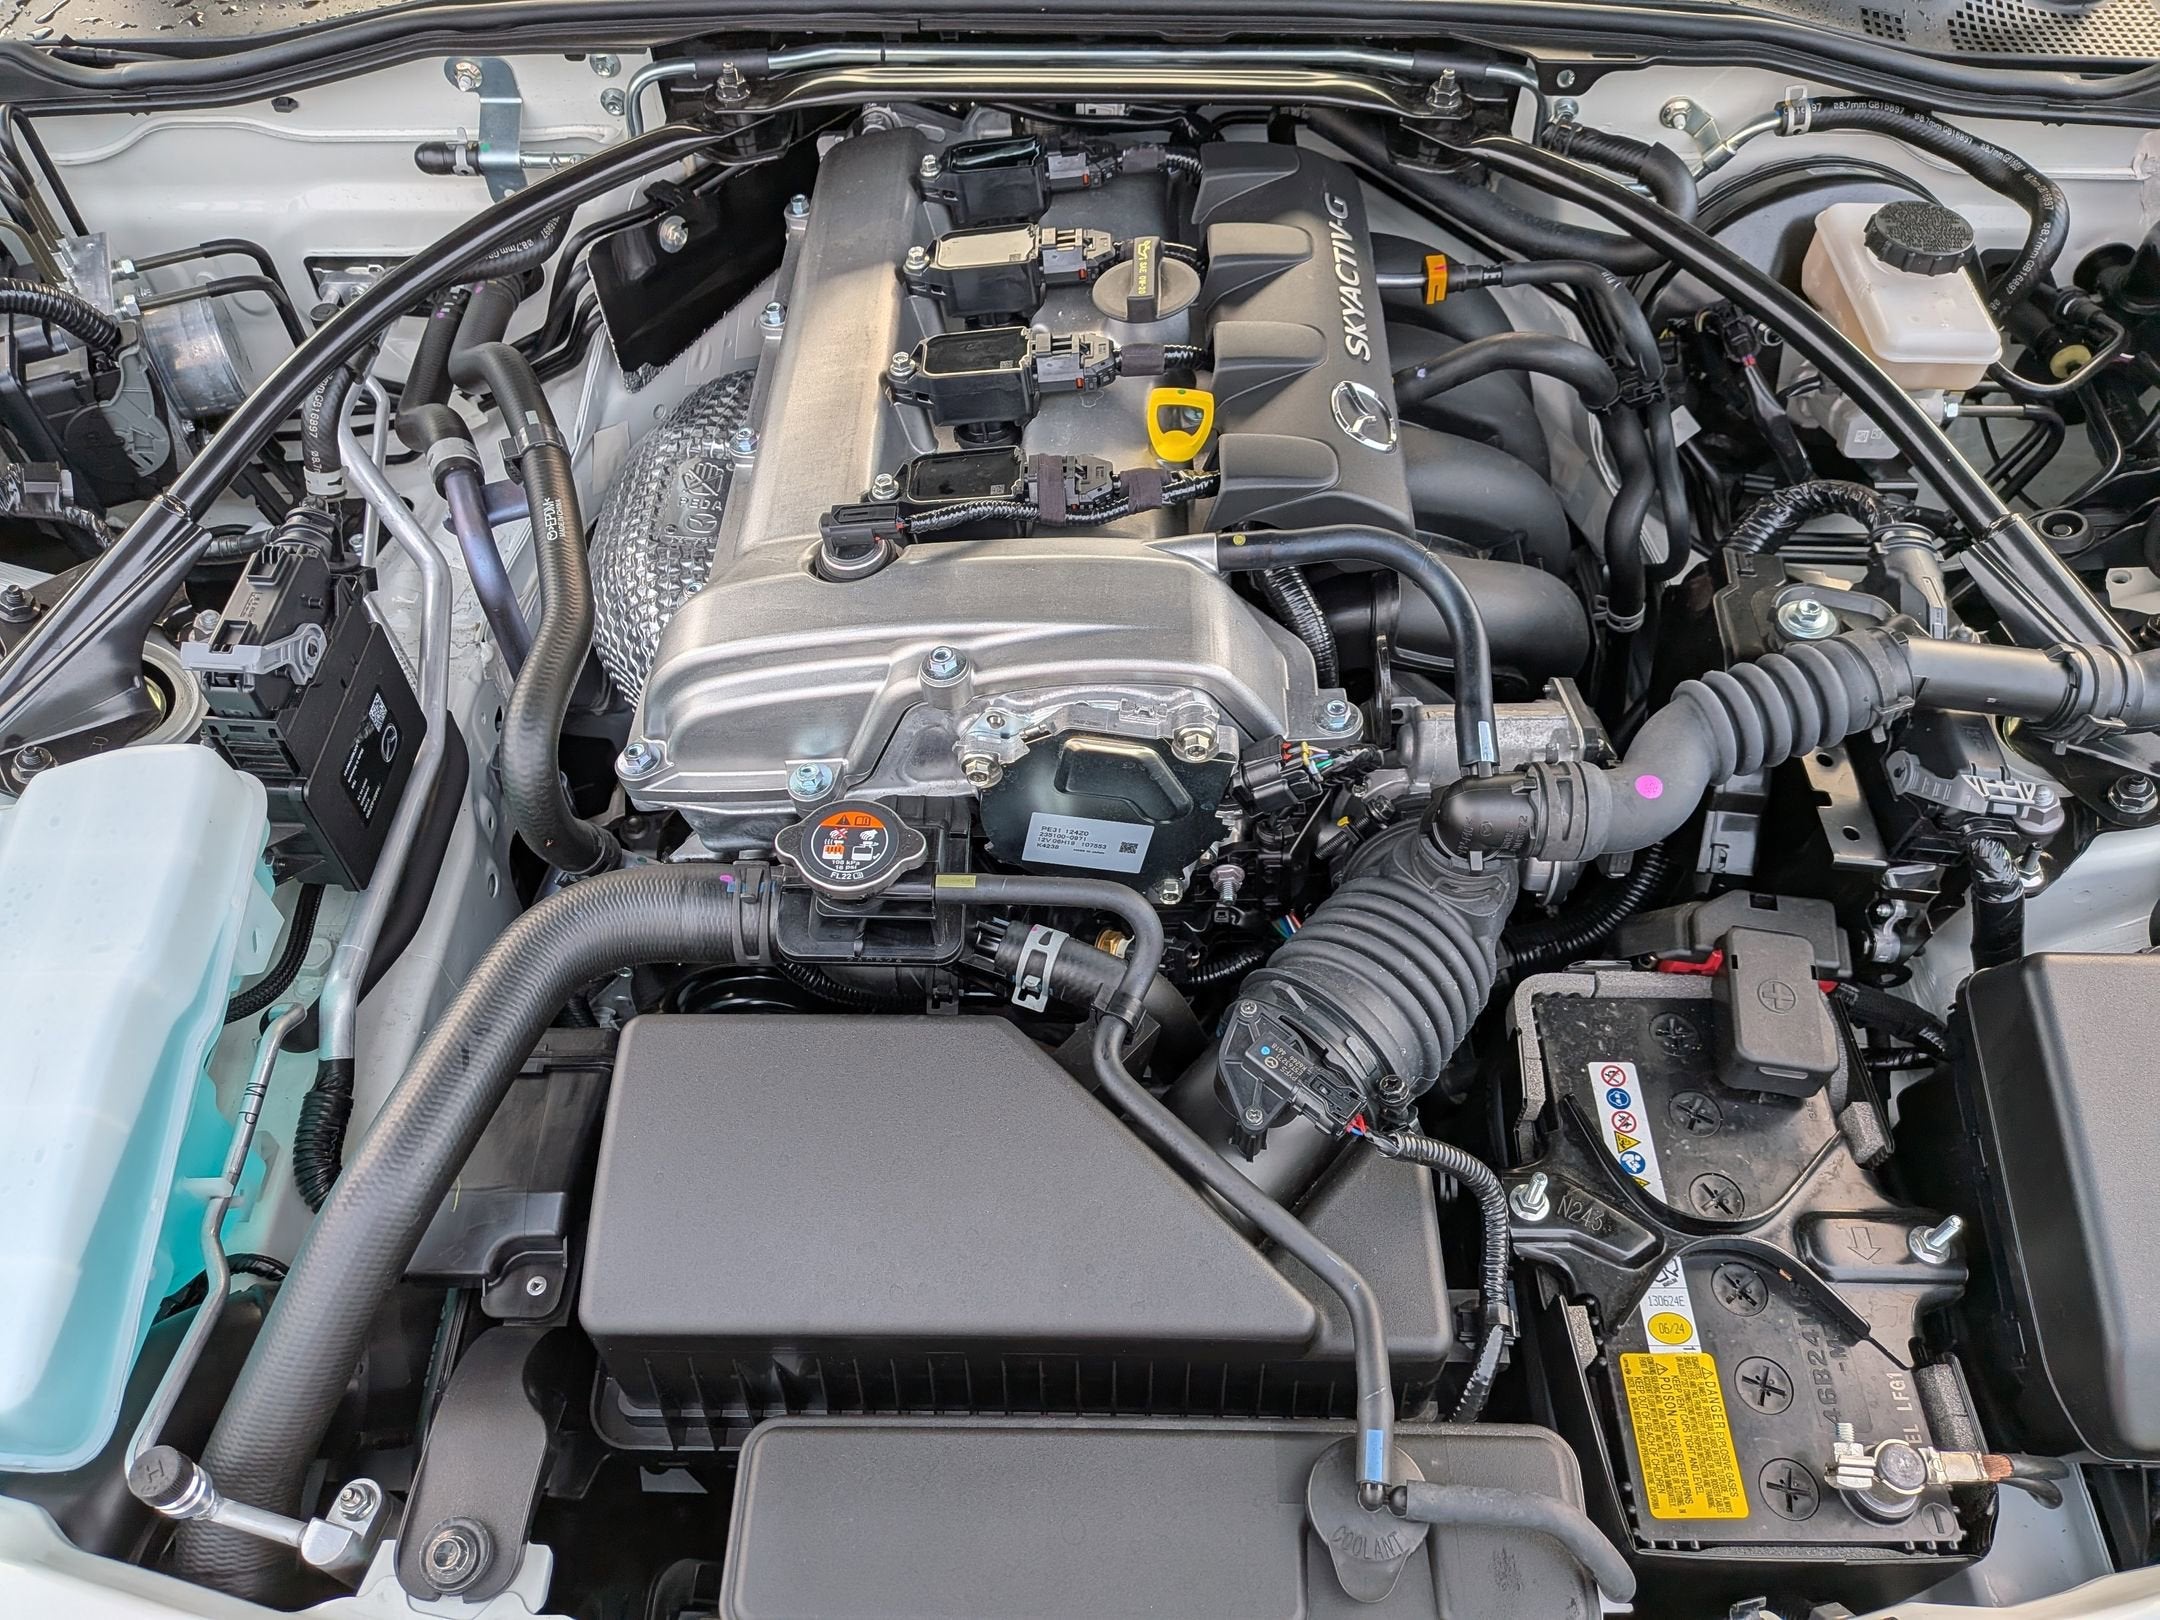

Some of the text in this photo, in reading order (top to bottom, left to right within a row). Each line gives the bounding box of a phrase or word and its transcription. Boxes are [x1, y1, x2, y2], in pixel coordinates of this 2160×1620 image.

[1325, 192, 1371, 362] SKYACTIV-G
[2006, 257, 2035, 295] GB16897
[308, 395, 324, 439] GB16897
[1040, 825, 1061, 834] PE31
[830, 872, 853, 880] FL22
[1648, 1295, 1686, 1307] 130624E
[1658, 1322, 1685, 1335] 06/24
[1887, 1372, 1913, 1411] LFG1
[1633, 1376, 1666, 1494] KEEP OUT OF REACH OF CHILDREN
[1658, 1376, 1693, 1504] POISON CAUSES SEVERE BURNS
[1670, 1374, 1704, 1494] KEEP VENT CAPS TIGHT AND LEVEL
[1704, 1381, 1739, 1497] DANGER EXPLOSIVE GASES
[1330, 1525, 1404, 1561] COOLANT
